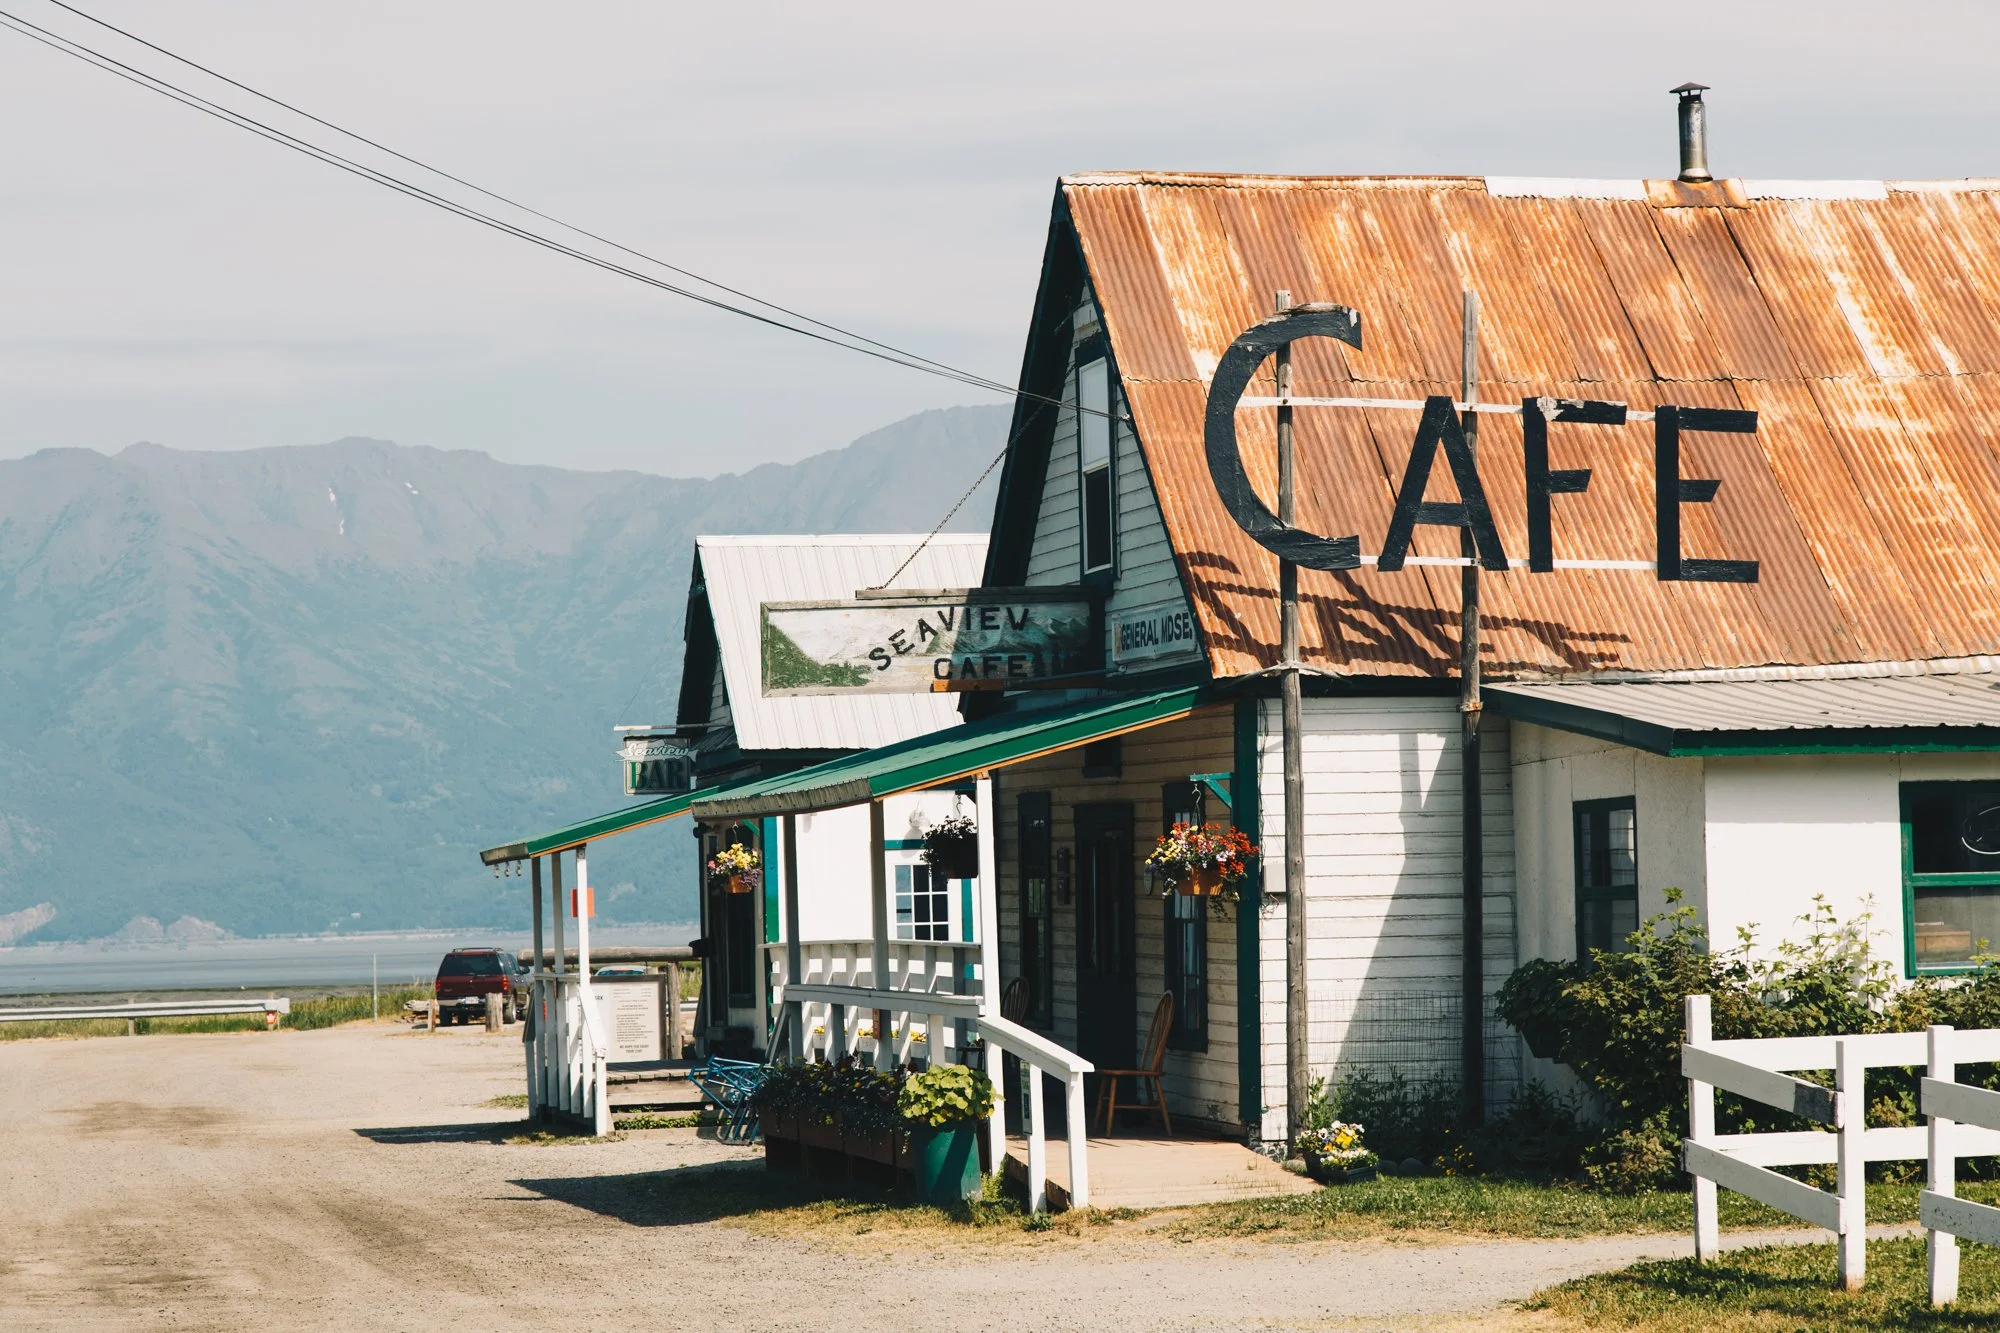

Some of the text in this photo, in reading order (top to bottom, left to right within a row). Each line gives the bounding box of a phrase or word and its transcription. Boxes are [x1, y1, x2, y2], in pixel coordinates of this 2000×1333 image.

[1205, 302, 1759, 583] CAFE
[868, 606, 1030, 671] SEAVIEW
[1121, 618, 1159, 651] GENERAL
[933, 655, 1028, 680] CAFE
[627, 742, 689, 758] Seaview
[630, 761, 686, 789] BAR
